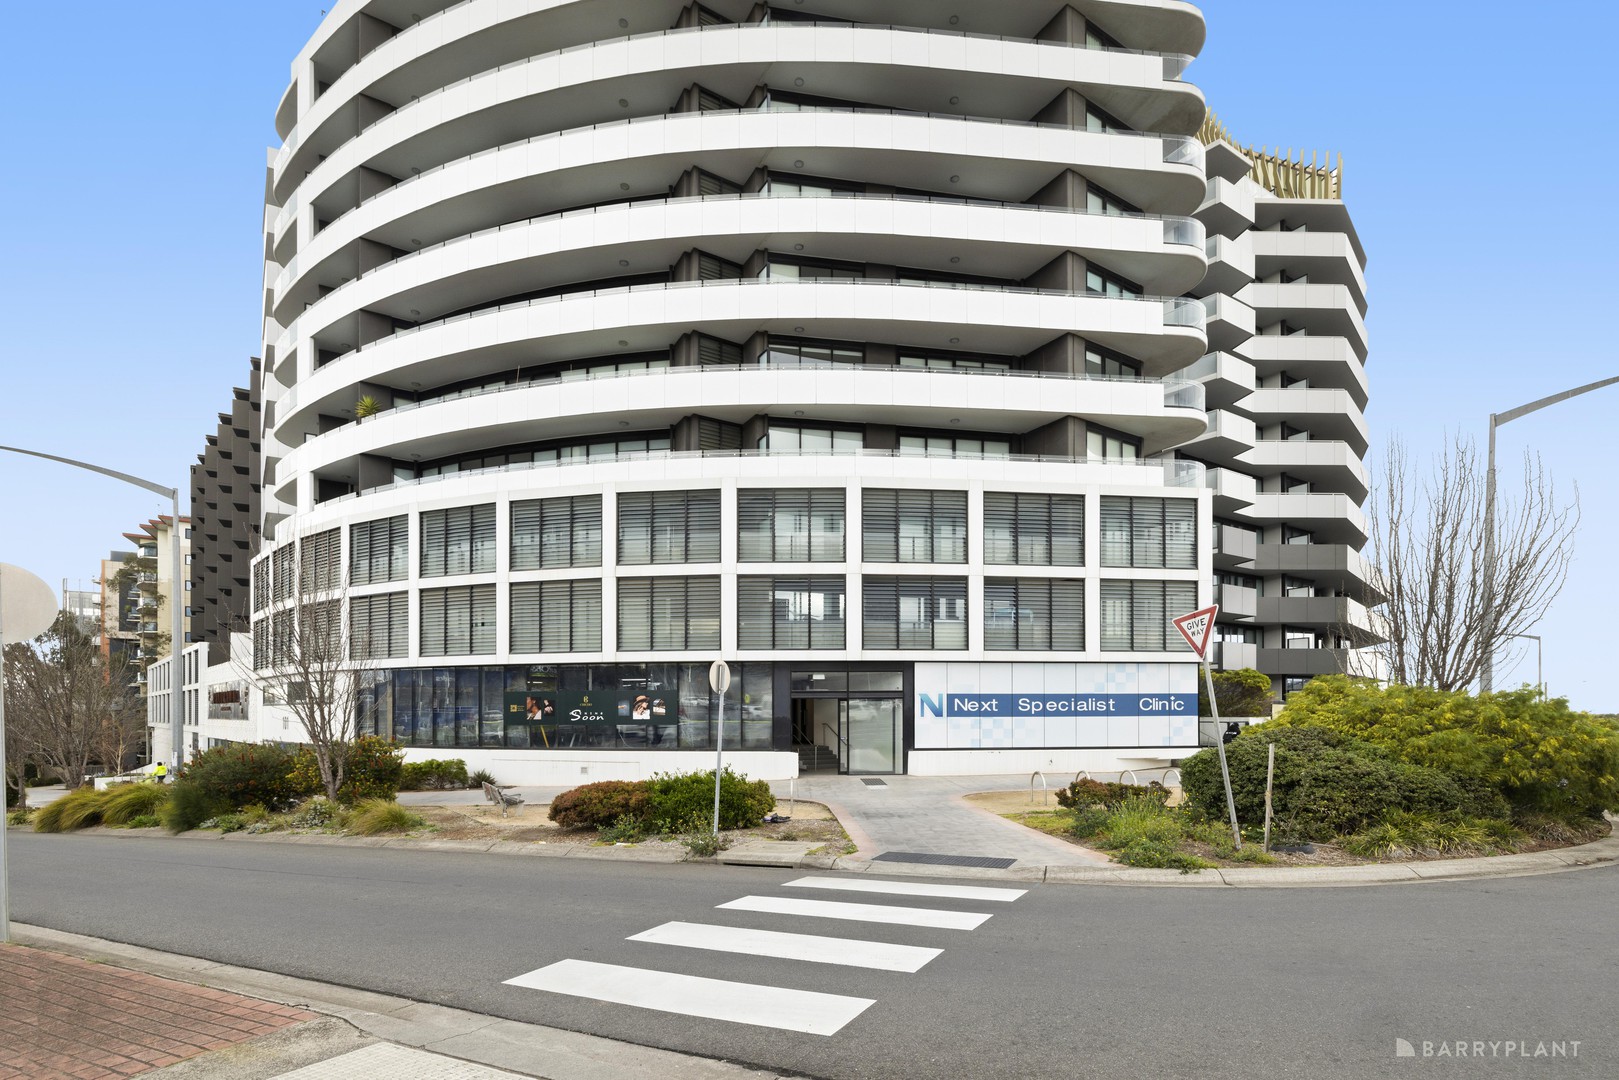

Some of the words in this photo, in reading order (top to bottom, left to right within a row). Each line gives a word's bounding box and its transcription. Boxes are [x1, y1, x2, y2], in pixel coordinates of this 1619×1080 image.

[1186, 617, 1206, 631] GIVE
[1190, 627, 1205, 637] WAY
[954, 698, 998, 711] Next
[1018, 698, 1116, 714] Specialist
[1139, 696, 1184, 711] Clinic
[570, 709, 605, 721] Soon
